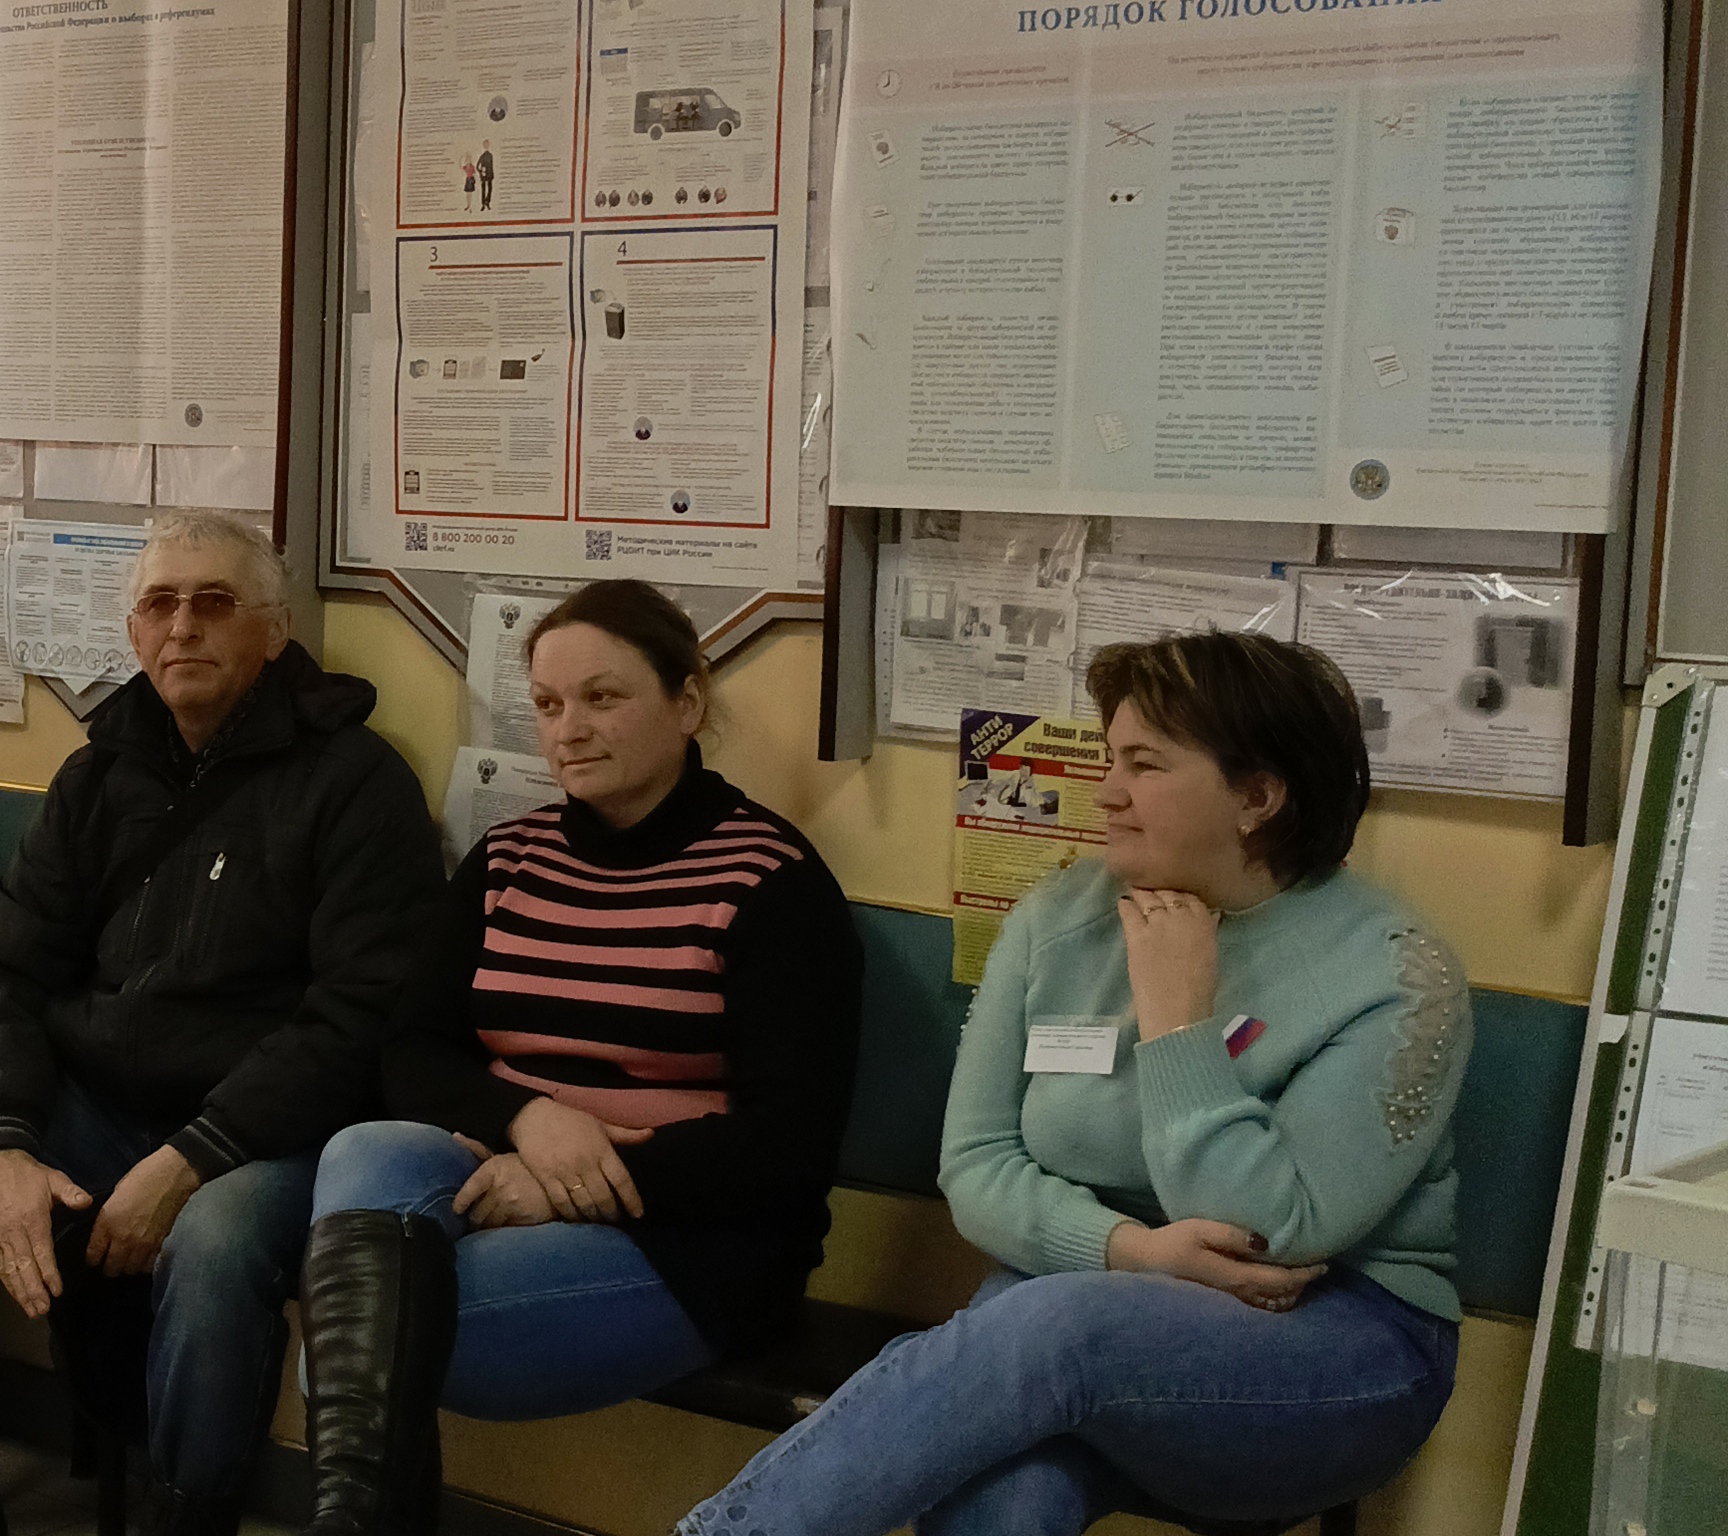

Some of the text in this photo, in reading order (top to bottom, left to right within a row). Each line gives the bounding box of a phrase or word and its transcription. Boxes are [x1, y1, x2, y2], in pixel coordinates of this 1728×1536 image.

[12, 0, 108, 18] ОТВЕТСТВЕННОСТЬ
[1017, 0, 1167, 33] ПОРЯДОК
[429, 246, 439, 262] 3
[617, 241, 628, 256] 4
[442, 532, 461, 542] 800
[463, 533, 482, 543] 200
[485, 534, 499, 544] 00
[501, 535, 515, 545] 20
[970, 715, 1004, 746] АНТИ
[1043, 723, 1077, 741] Ваши
[970, 723, 1015, 761] ТЕРРОР
